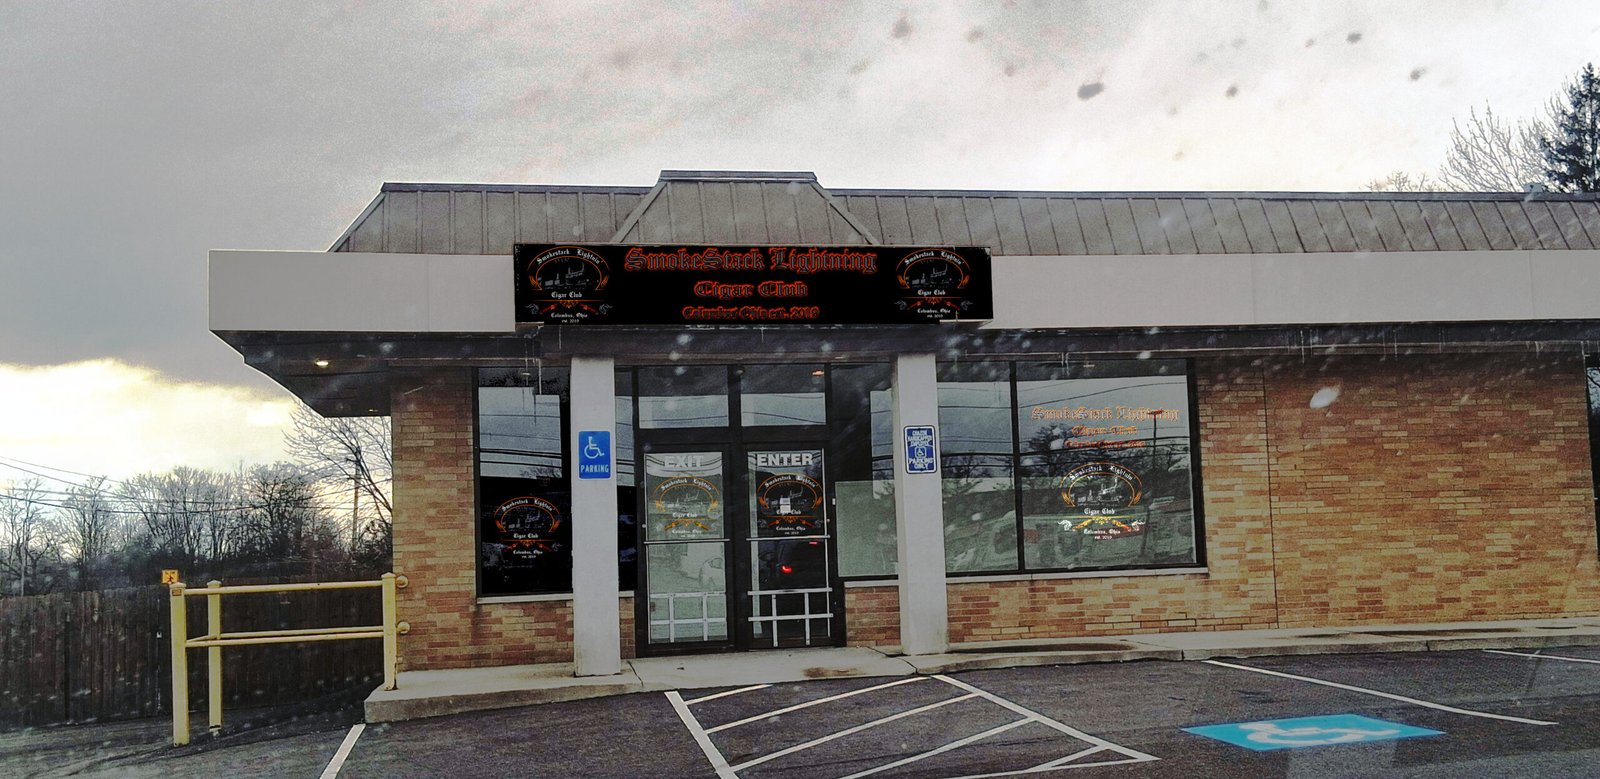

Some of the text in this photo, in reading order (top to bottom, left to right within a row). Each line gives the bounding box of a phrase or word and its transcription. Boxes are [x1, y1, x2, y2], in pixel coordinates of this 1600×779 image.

[624, 246, 878, 274] SmokeStack Lightning
[551, 291, 567, 300] Cigar
[694, 280, 808, 299] Cigar Club
[664, 455, 704, 468] EXIT
[757, 453, 813, 466] ENTER
[580, 464, 609, 473] PARKING
